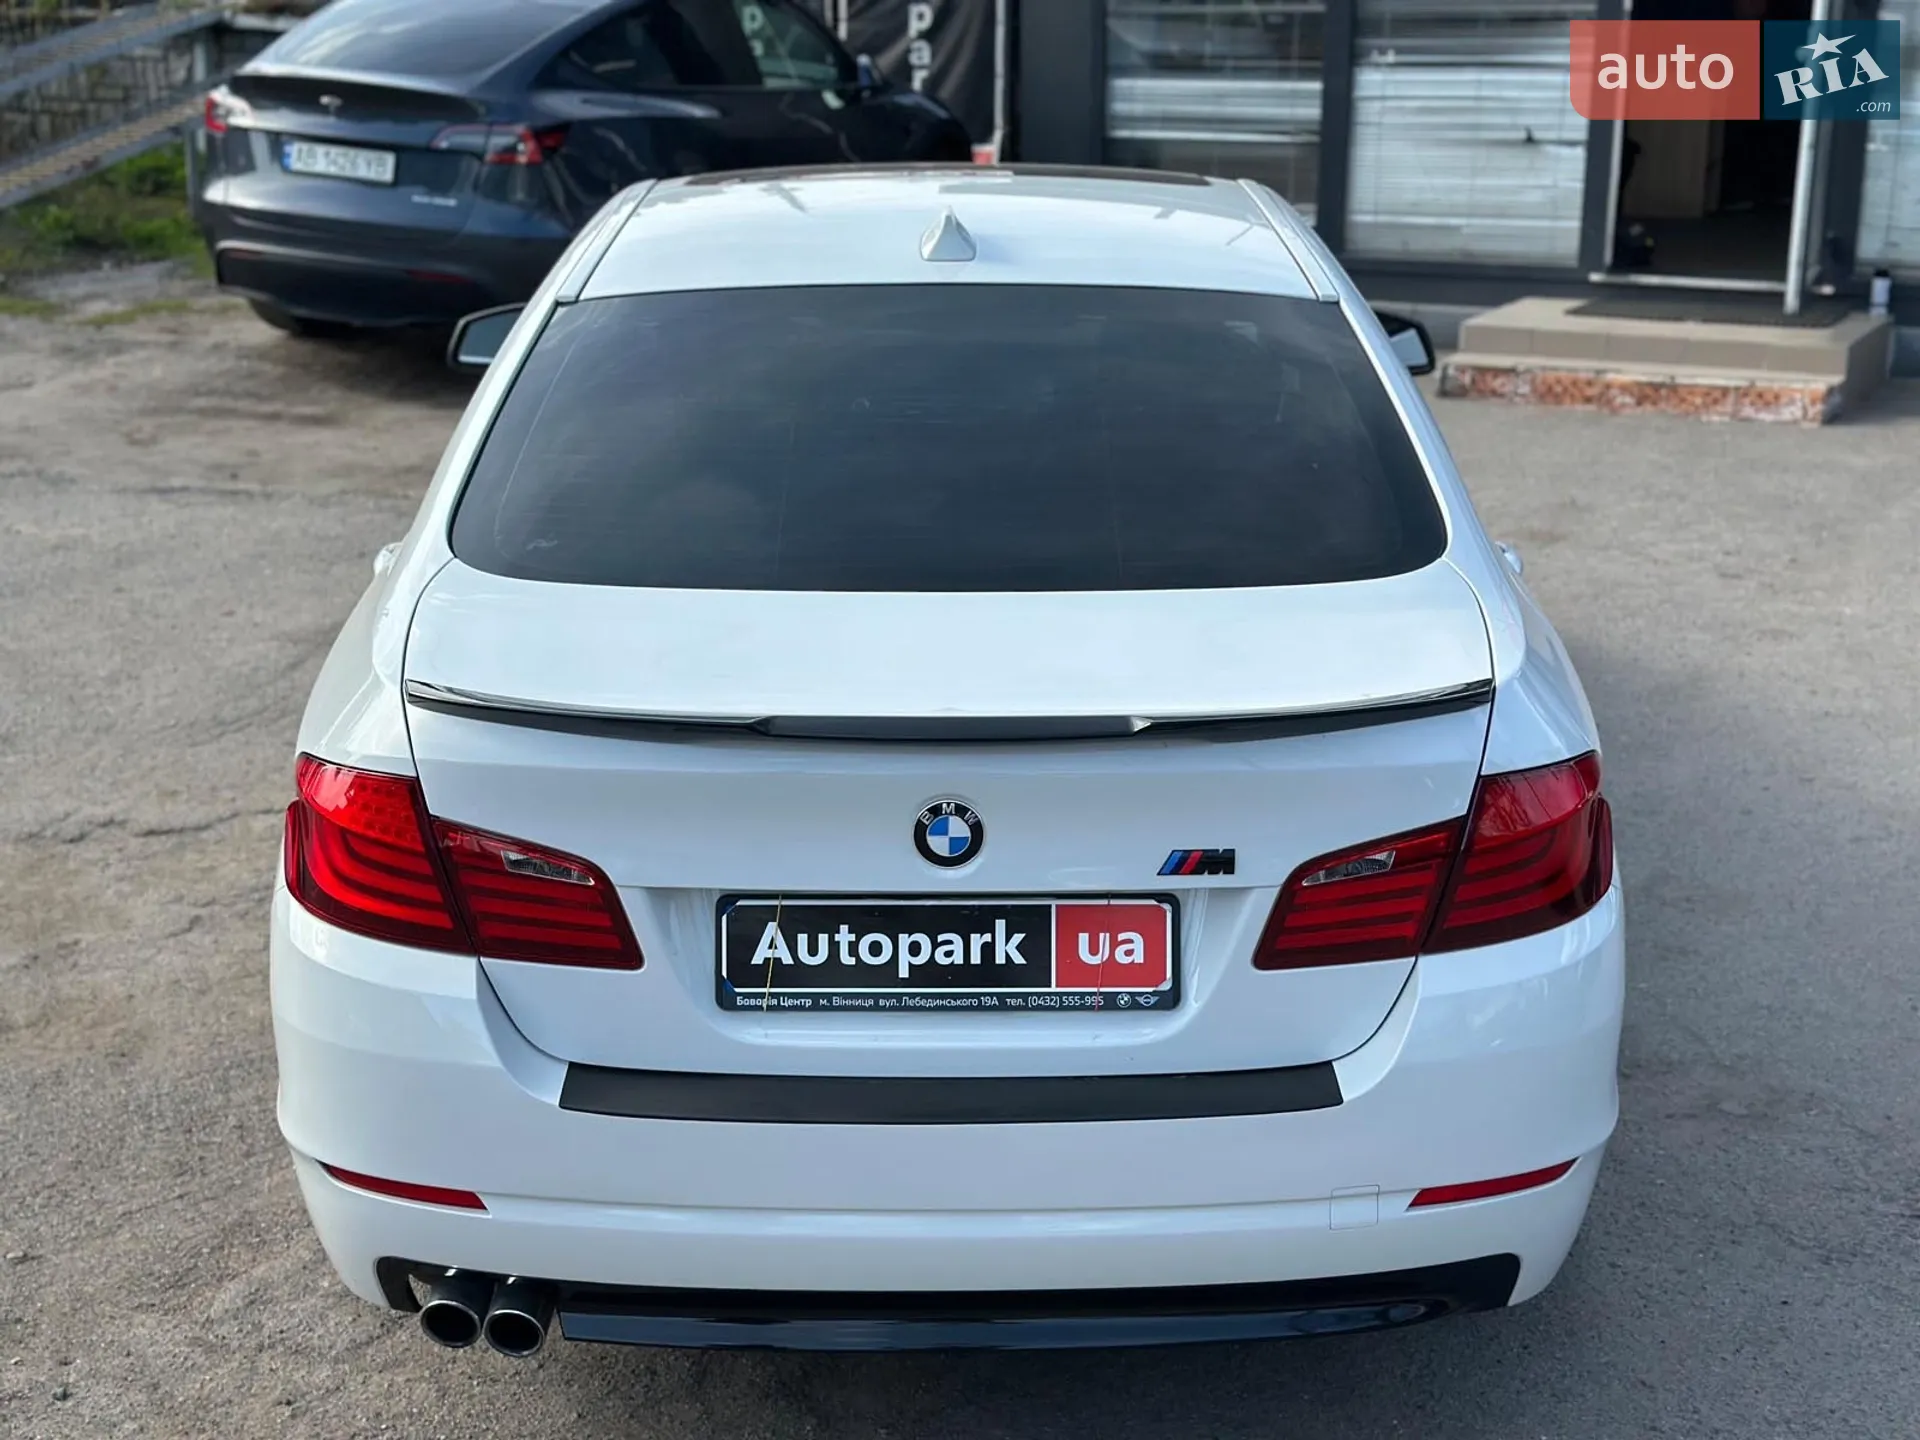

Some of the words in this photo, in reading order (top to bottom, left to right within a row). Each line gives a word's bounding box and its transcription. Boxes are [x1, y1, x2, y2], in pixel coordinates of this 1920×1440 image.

[920, 803, 978, 825] BMW
[750, 919, 1027, 978] Autopark
[1078, 931, 1144, 965] ua
[780, 996, 812, 1007] Центр
[832, 996, 874, 1007] Вінниця
[879, 998, 900, 1008] вул.
[901, 996, 978, 1008] Лебединського
[1005, 998, 1026, 1006] тел.
[1028, 996, 1060, 1008] (0432)
[1062, 996, 1104, 1006] 555-995
